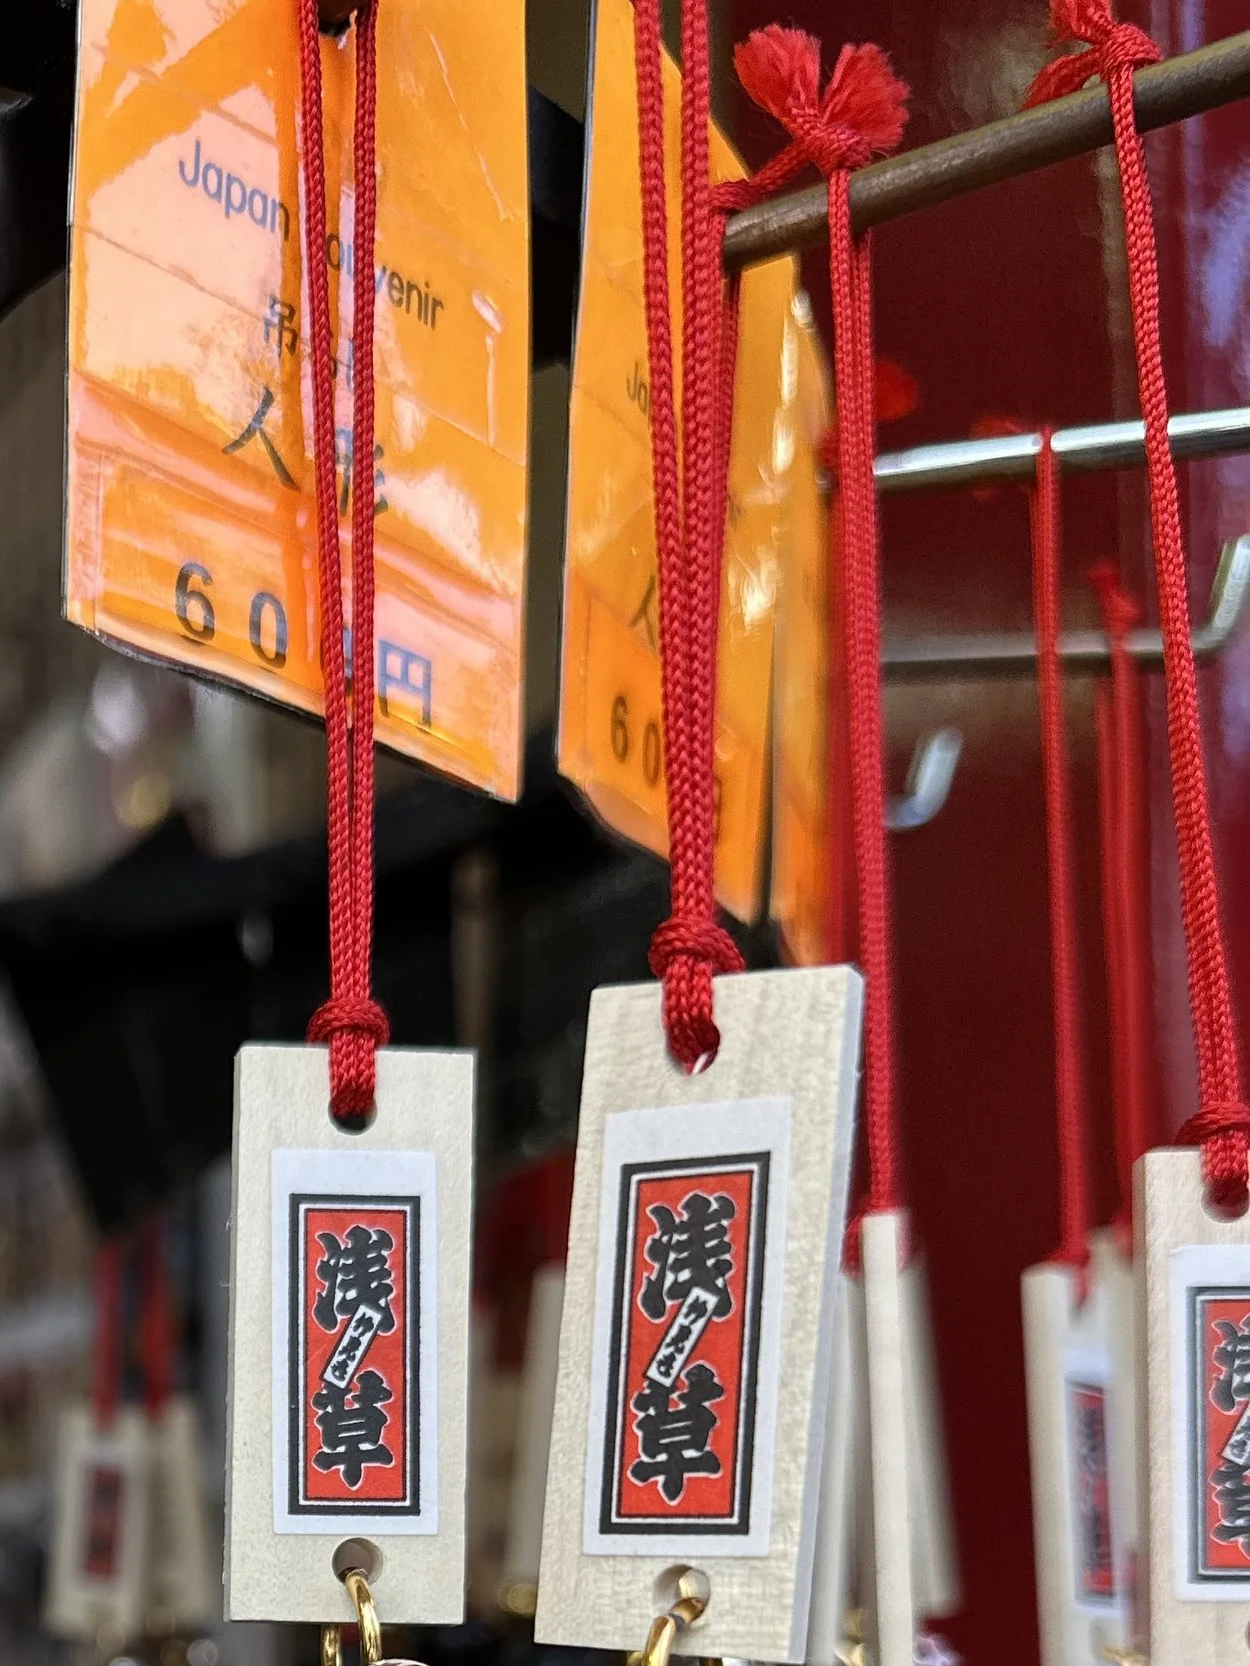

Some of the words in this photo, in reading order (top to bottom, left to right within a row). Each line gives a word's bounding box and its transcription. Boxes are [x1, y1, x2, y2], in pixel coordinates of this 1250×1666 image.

[178, 140, 290, 241] Japan
[175, 562, 432, 730] 60円
[312, 1225, 394, 1488] 浅草
[629, 1194, 735, 1502] 浅草
